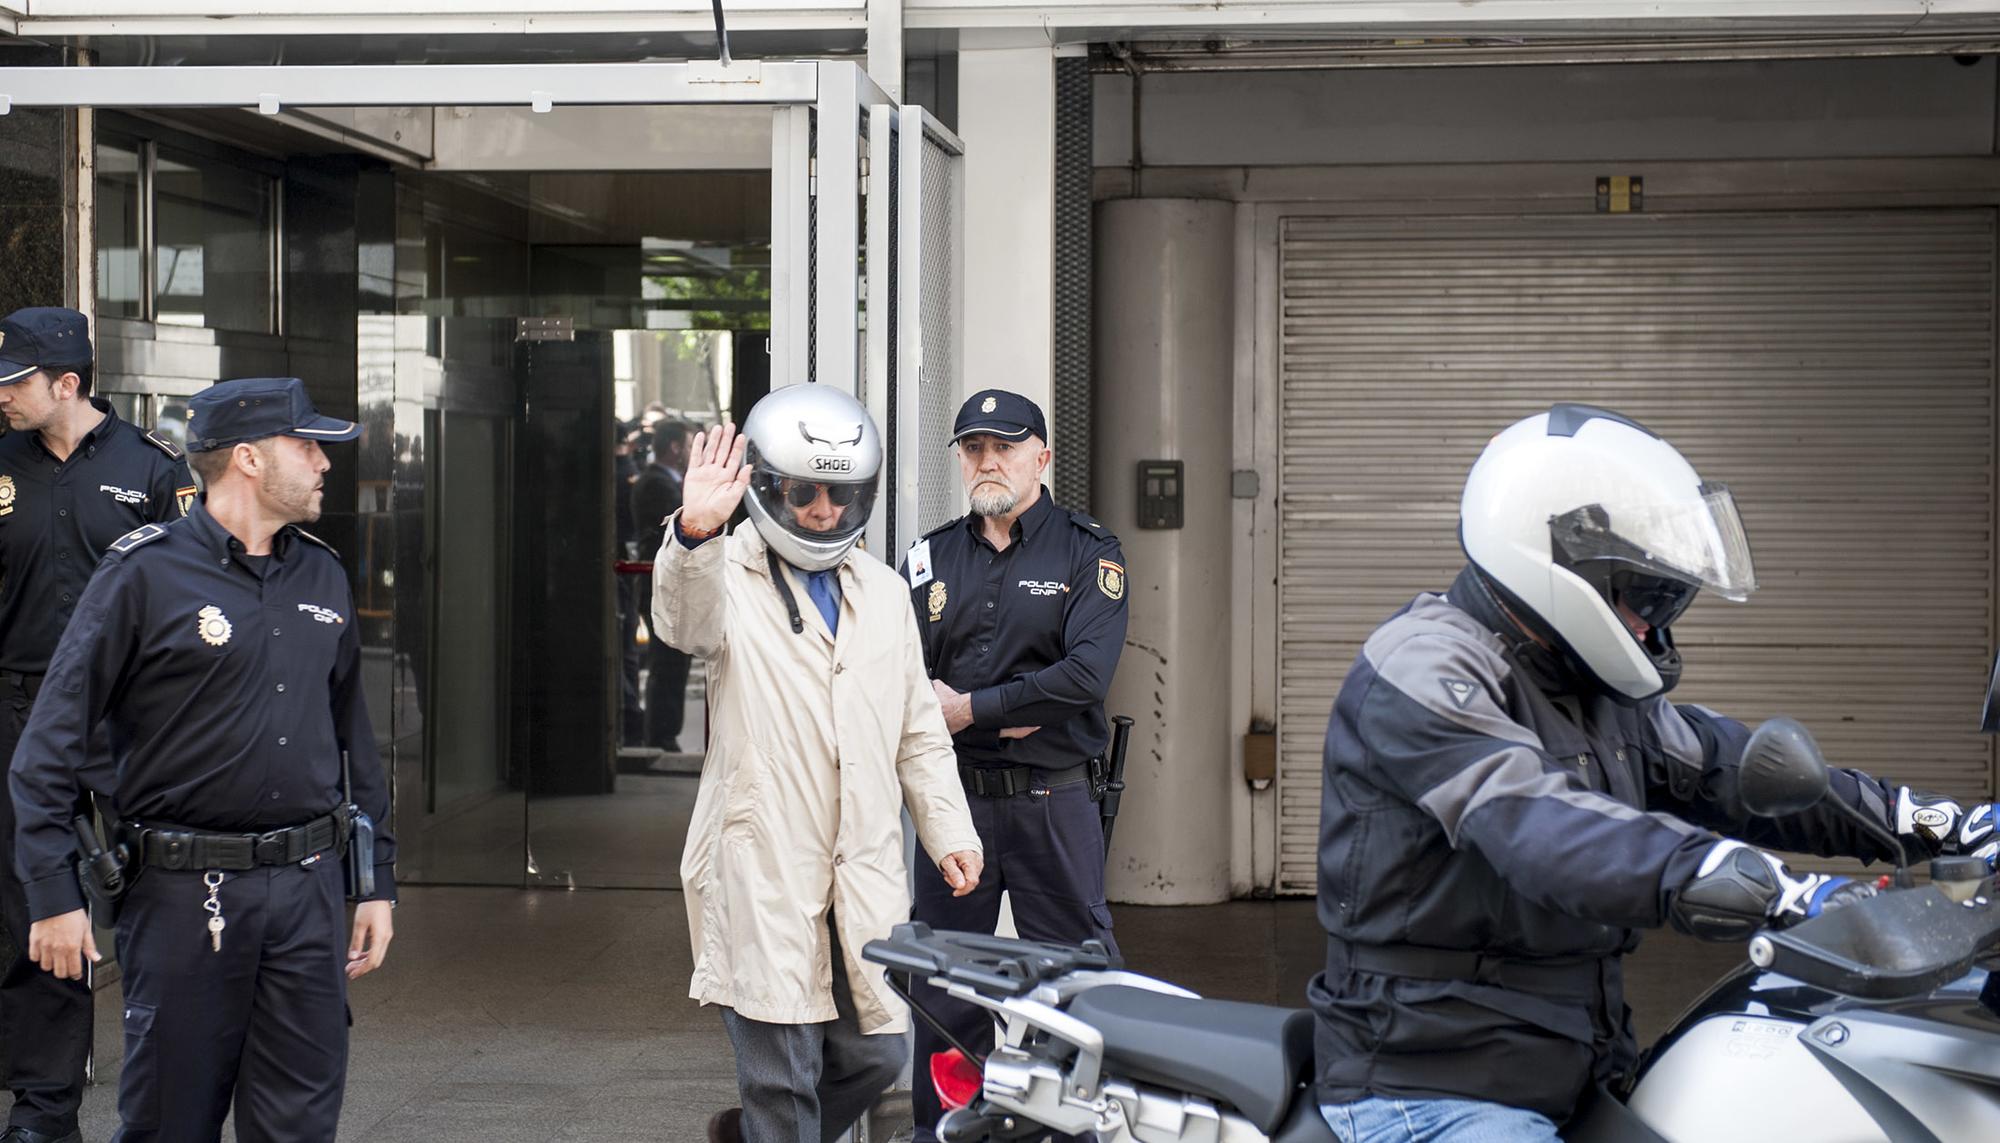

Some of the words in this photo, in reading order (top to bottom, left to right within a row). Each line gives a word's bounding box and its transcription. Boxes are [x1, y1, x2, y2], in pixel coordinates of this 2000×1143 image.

[815, 458, 850, 471] SHOEI
[114, 494, 140, 503] CNP
[1018, 580, 1066, 592] POLICIA
[1030, 588, 1057, 597] CNP
